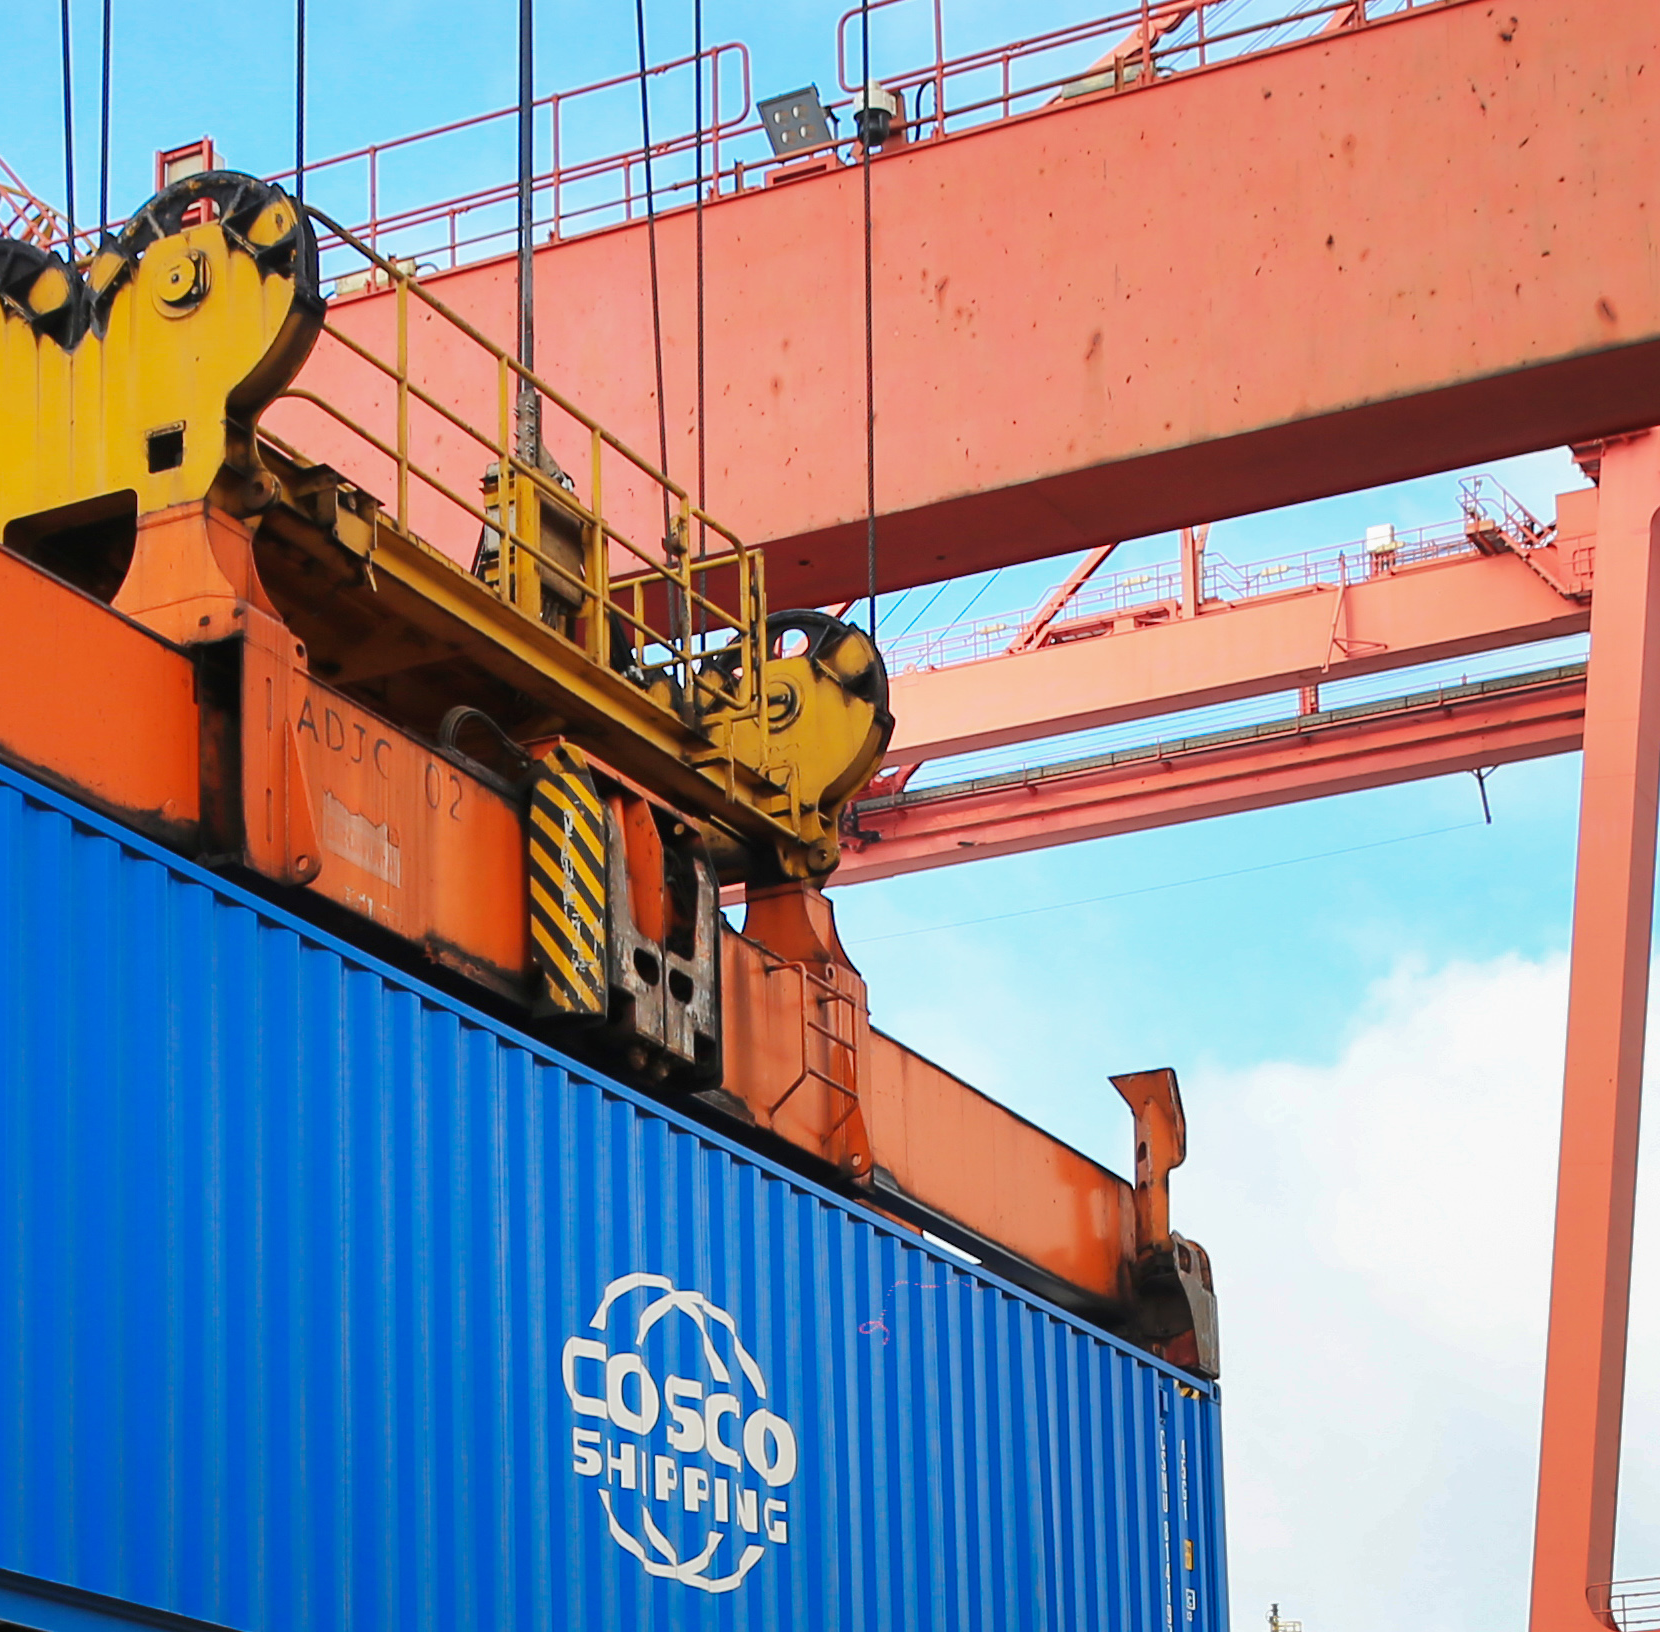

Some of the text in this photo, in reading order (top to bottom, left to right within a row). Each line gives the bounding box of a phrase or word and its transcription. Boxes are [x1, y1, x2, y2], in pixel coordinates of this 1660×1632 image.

[425, 763, 462, 822] 02
[562, 1335, 798, 1487] COSCO
[571, 1426, 788, 1545] SHIPPING
